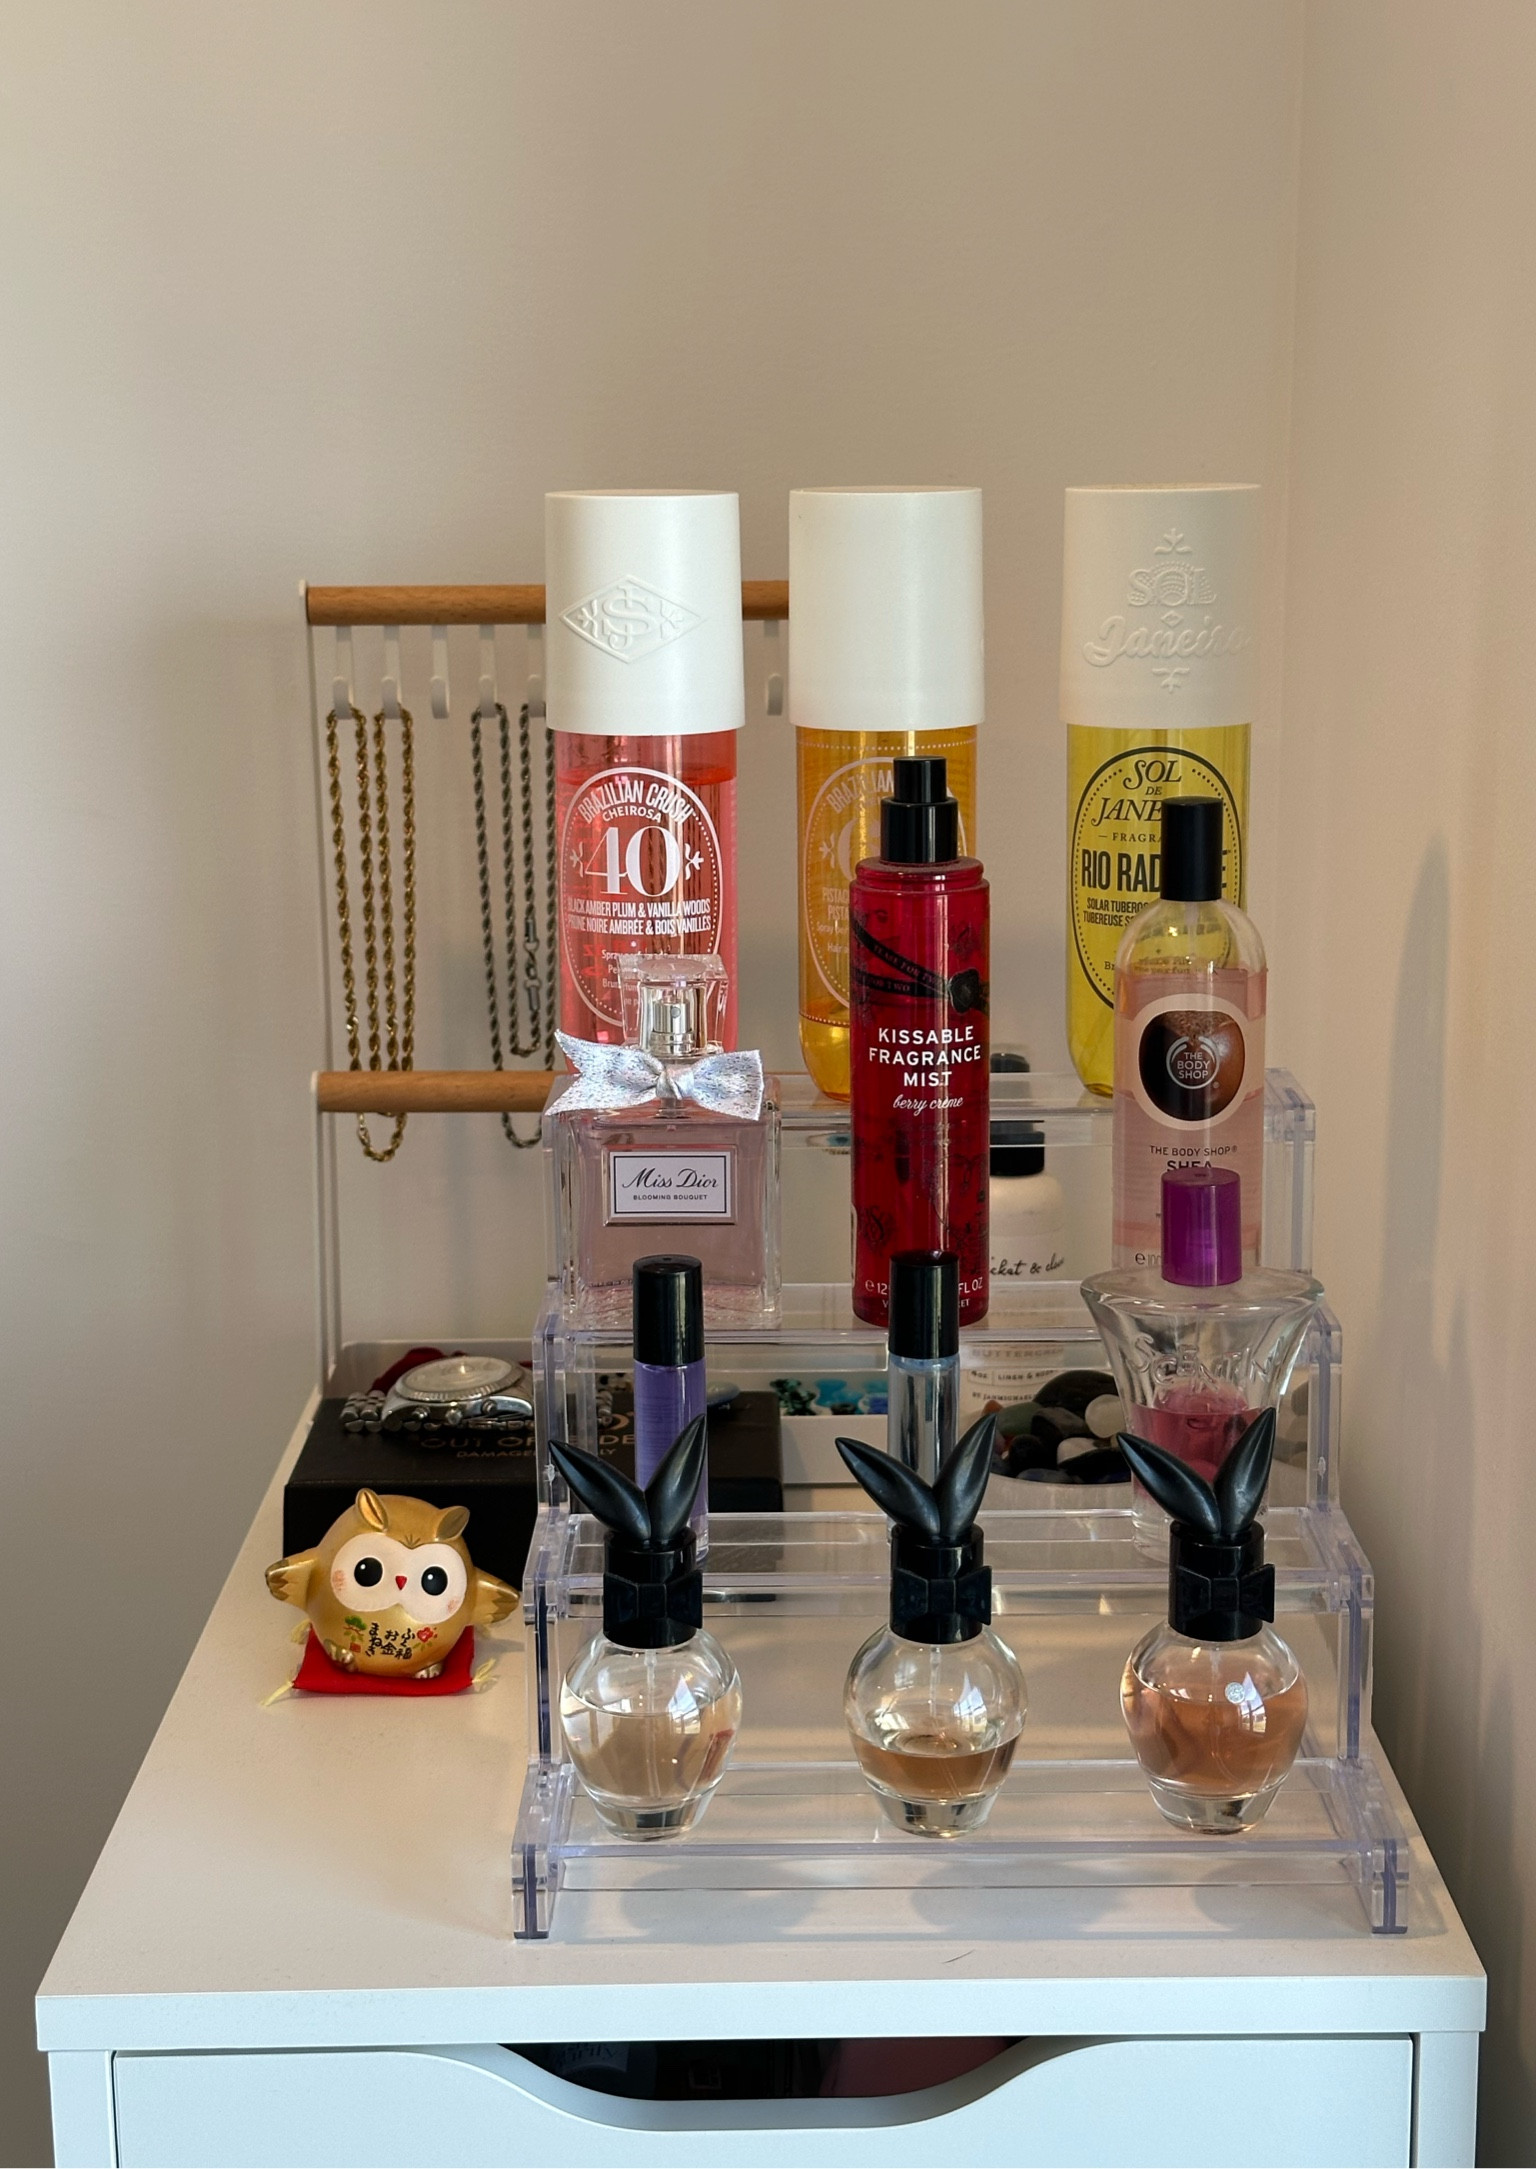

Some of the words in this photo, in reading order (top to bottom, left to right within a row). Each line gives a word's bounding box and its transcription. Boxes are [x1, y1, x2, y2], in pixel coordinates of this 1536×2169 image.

[1122, 760, 1182, 790] SOL
[1145, 786, 1163, 796] DE
[577, 779, 644, 824] BRAZILIAN
[602, 805, 663, 823] CHEIROSA
[1091, 797, 1162, 827] JANE
[1112, 832, 1162, 843] FRAGR
[585, 825, 682, 897] 40
[1081, 848, 1112, 890] RIO
[586, 899, 612, 916] AMBER
[613, 902, 637, 918] PLUM
[638, 902, 646, 918] &
[647, 901, 683, 918] VANILLA
[683, 898, 711, 916] WOODS
[1087, 897, 1110, 912] SOLAR
[587, 916, 609, 934] NOIRE
[609, 918, 644, 935] AMBRÉE
[645, 919, 654, 935] &
[655, 919, 677, 936] BOIS
[1083, 910, 1124, 927] TUBEREUSE
[878, 1025, 974, 1045] KISSABLE
[869, 1044, 981, 1066] FRAGRANCE
[1183, 1051, 1203, 1061] THE
[1176, 1060, 1211, 1071] BODY
[903, 1071, 953, 1087] MIST
[1178, 1069, 1209, 1080] SHOP
[892, 1094, 928, 1117] berry
[1149, 1145, 1169, 1156] THE
[1171, 1147, 1200, 1157] BODY
[621, 1167, 673, 1188] Miss
[676, 1168, 719, 1188] Dior
[971, 1277, 984, 1290] OZ
[420, 1436, 482, 1448] OUT
[456, 1449, 537, 1458] DAMAGE
